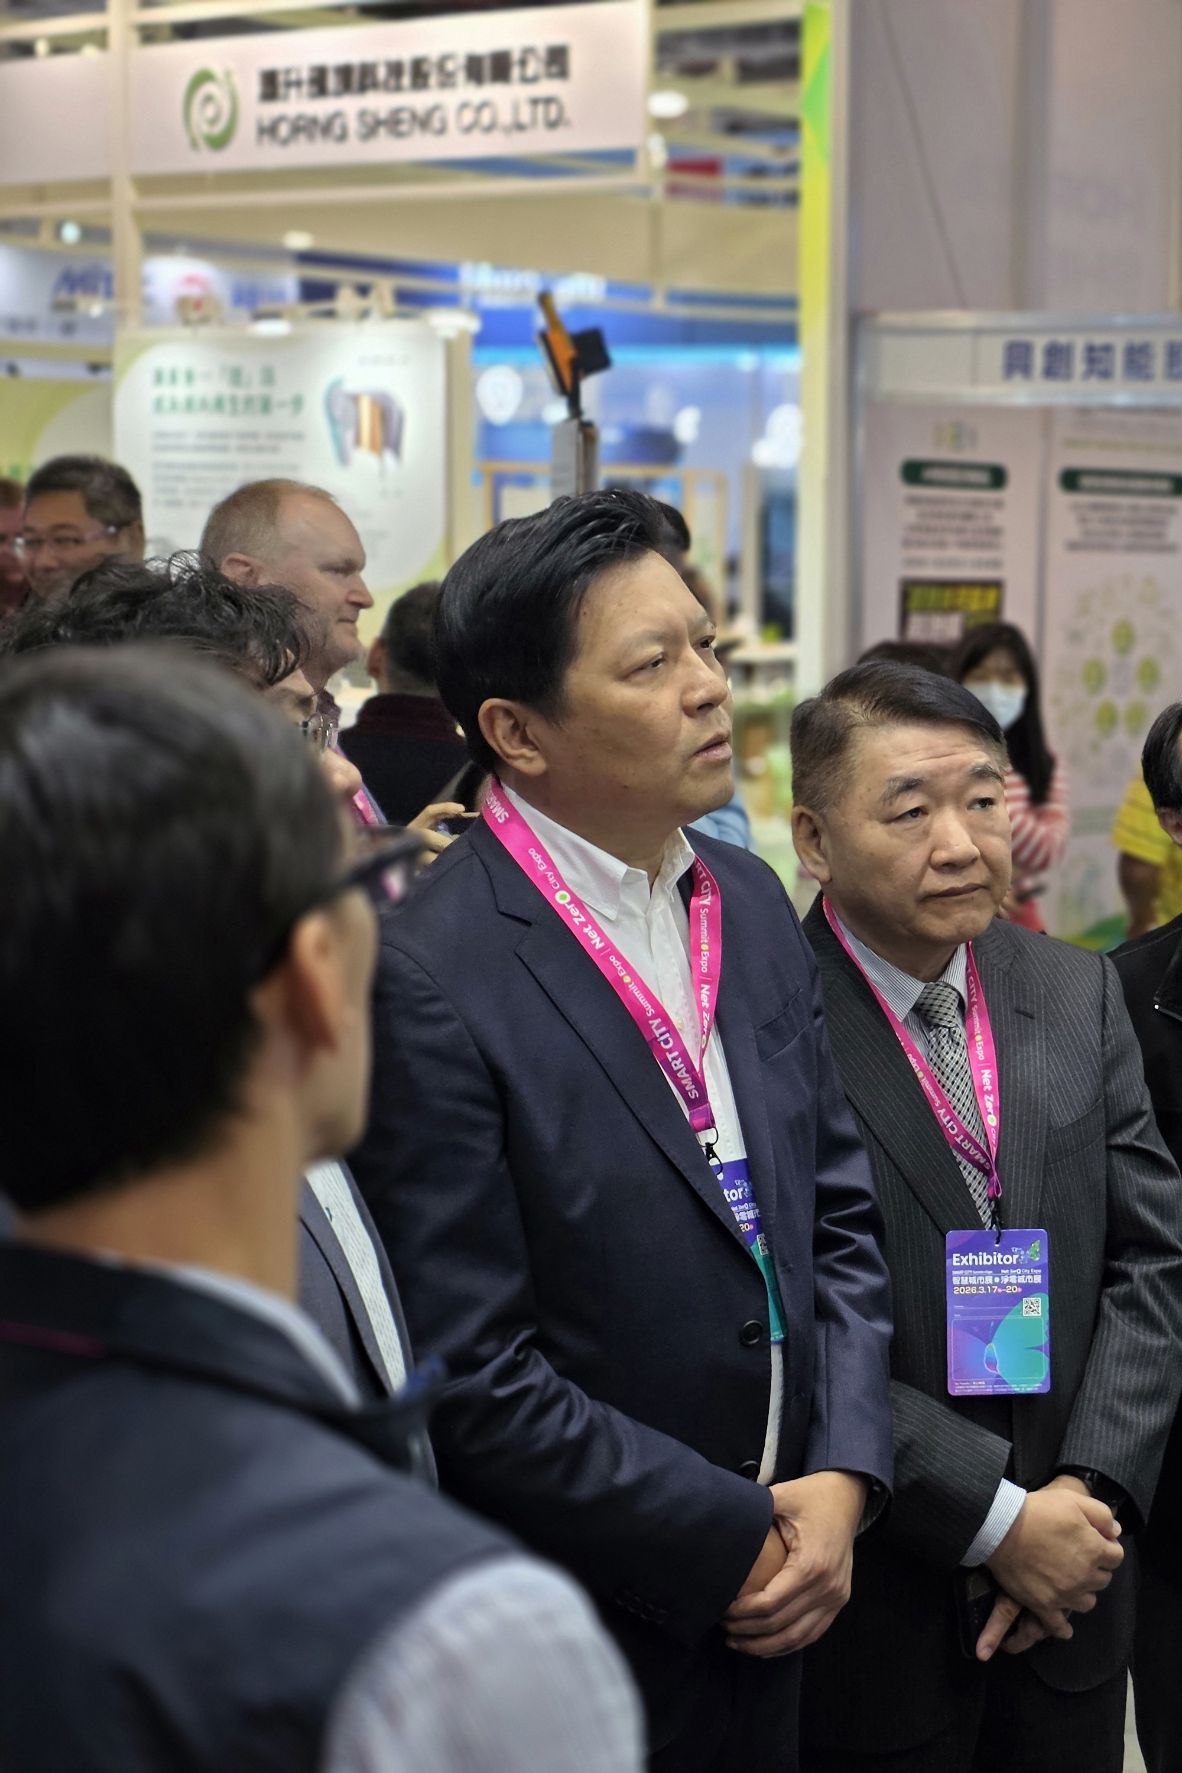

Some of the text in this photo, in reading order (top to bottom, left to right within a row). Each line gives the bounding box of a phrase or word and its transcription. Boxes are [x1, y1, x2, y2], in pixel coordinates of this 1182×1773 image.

[257, 109, 348, 146] HORNG
[357, 104, 448, 141] SHENG
[528, 847, 547, 871] Expo
[545, 871, 560, 890] City
[699, 880, 711, 905] CITY
[583, 927, 605, 950] Net
[699, 908, 708, 944] Summit
[609, 955, 626, 977] Expo
[701, 951, 709, 973] Expo
[628, 982, 655, 1017] Summit
[700, 984, 710, 1008] Net
[648, 1018, 674, 1049] CITY
[666, 1051, 699, 1100] SMART
[975, 1040, 985, 1060] Expo
[981, 1069, 993, 1091] Net
[937, 1108, 958, 1135] CITY
[952, 1252, 1019, 1266] Exhibitor
